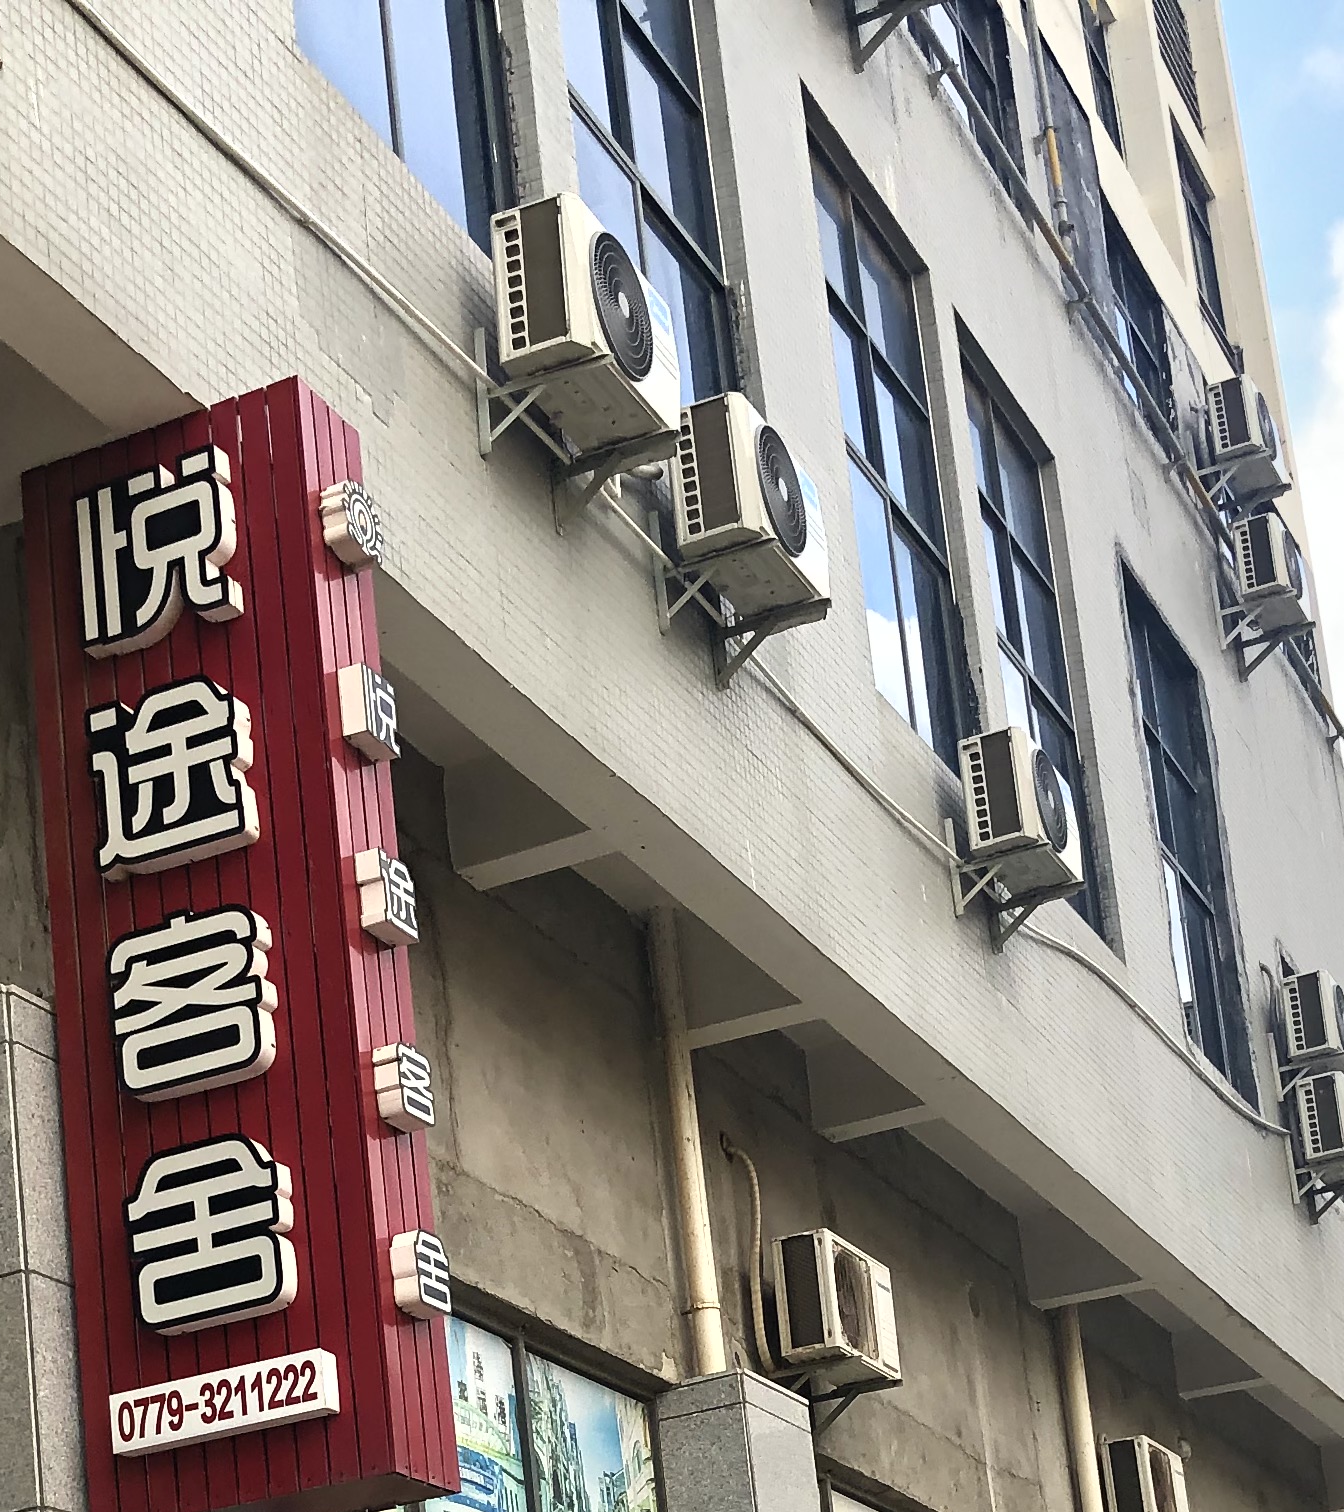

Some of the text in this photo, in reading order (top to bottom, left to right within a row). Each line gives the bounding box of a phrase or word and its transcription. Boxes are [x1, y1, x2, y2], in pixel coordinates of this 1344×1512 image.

[74, 446, 286, 1332] 悦途客舍
[361, 664, 452, 1313] 悦途客舍
[117, 1360, 319, 1442] 0779-3211222
